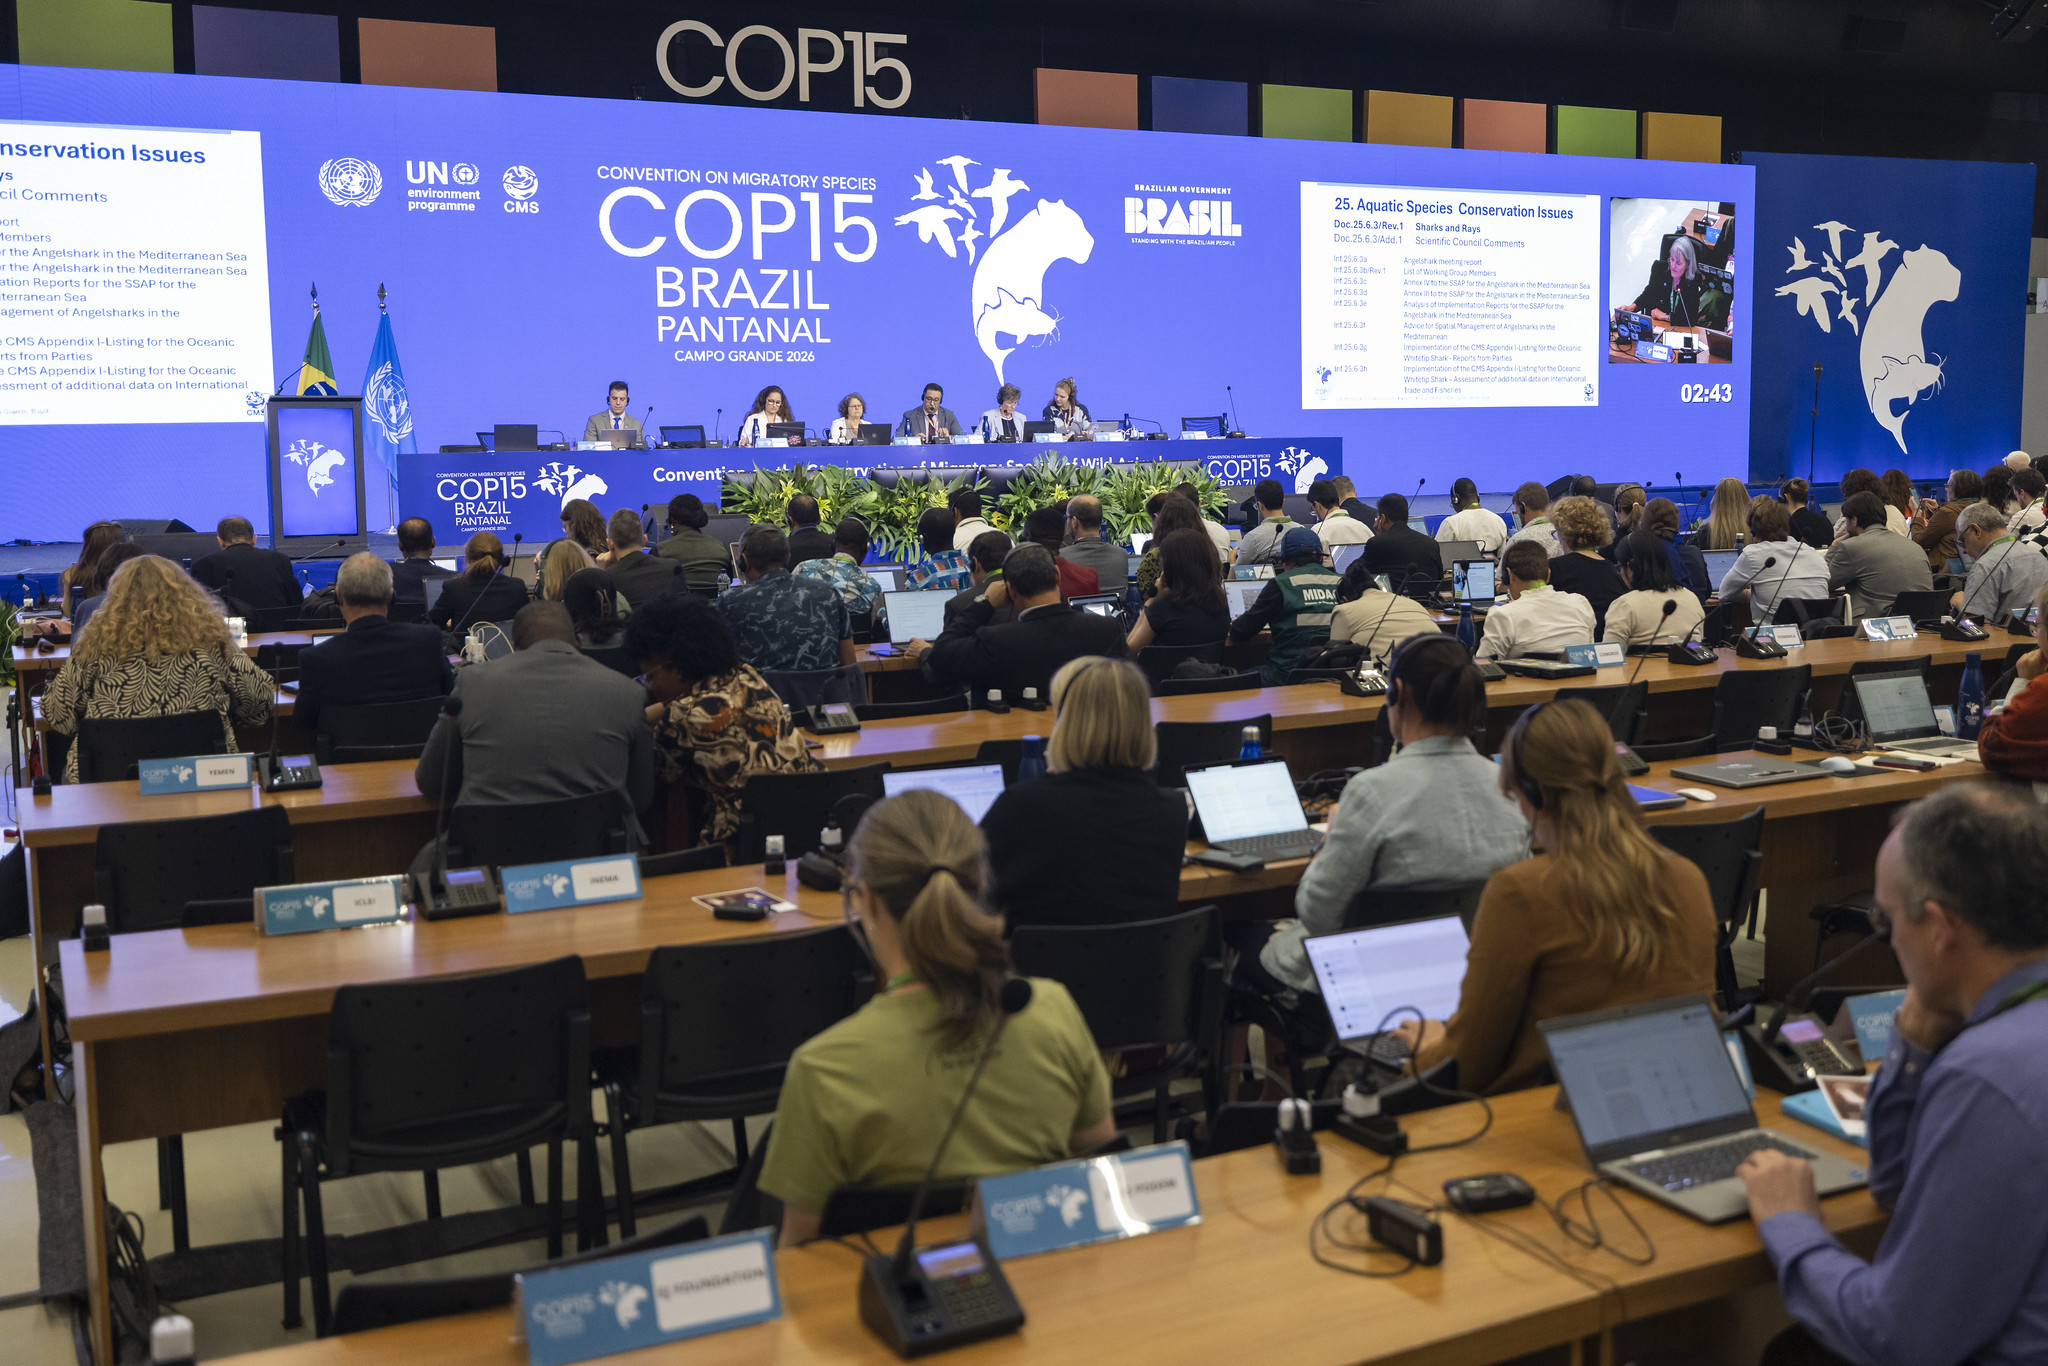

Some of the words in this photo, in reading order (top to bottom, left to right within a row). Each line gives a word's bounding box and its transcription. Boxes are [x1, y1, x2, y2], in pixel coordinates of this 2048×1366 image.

[656, 19, 912, 109] COP15
[0, 142, 125, 160] nservation
[132, 144, 206, 164] Issues
[406, 160, 448, 184] UN
[597, 166, 700, 182] CONVENTION
[706, 170, 728, 184] ON
[733, 172, 818, 188] MIGRATORY
[822, 176, 876, 190] SPECIES
[22, 188, 108, 202] Comments
[408, 188, 481, 200] environment
[1134, 184, 1178, 192] BRAZILIAN
[1180, 186, 1232, 194] GOVERNMENT
[408, 201, 476, 212] programme
[504, 200, 540, 214] CMS
[1335, 197, 1354, 210] 25.
[1357, 198, 1404, 214] Aquatic
[1406, 200, 1453, 216] Species
[1458, 202, 1535, 218] Conservation
[1538, 206, 1574, 219] Issues
[598, 186, 878, 262] COP15
[1124, 197, 1242, 237] BRASIL
[1334, 220, 1404, 230] Doc.25.6.3/Rev.1
[1416, 222, 1443, 232] Sharks
[1445, 224, 1460, 232] and
[1462, 224, 1480, 234] Rays
[1334, 234, 1402, 244] Doc.25.6.3/Add.1
[1416, 236, 1451, 246] Scientific
[1452, 238, 1482, 247] Council
[1484, 238, 1525, 248] Comments
[10, 248, 29, 256] the
[32, 248, 100, 259] Angelshark
[103, 250, 114, 258] in
[116, 250, 135, 258] the
[139, 251, 223, 260] Mediterranean
[226, 253, 247, 261] Sea
[32, 264, 100, 274] Angelshark
[116, 265, 135, 273] the
[139, 265, 223, 274] Mediterranean
[226, 267, 247, 275] Sea
[34, 278, 81, 288] Reports
[84, 279, 100, 287] for
[125, 280, 156, 288] SSAP
[159, 280, 176, 288] for
[178, 281, 196, 289] the
[656, 266, 830, 310] BRAZIL
[64, 293, 87, 301] Sea
[1, 309, 54, 318] agement
[57, 308, 69, 316] of
[72, 308, 145, 318] Angelsharks
[658, 316, 831, 343] PANTANAL
[6, 337, 34, 346] CMS
[38, 337, 94, 347] Appendix
[147, 338, 162, 346] for
[166, 338, 184, 346] the
[188, 338, 234, 346] Oceanic
[20, 352, 48, 360] from
[52, 352, 92, 360] Parties
[674, 350, 726, 362] CAMPO
[728, 350, 783, 362] GRANDE
[786, 350, 815, 362] 2026
[8, 367, 36, 375] CMS
[40, 367, 96, 377] Appendix
[189, 366, 236, 374] Oceanic
[51, 382, 63, 390] of
[176, 381, 248, 389] International
[1680, 384, 1732, 403] 02:43
[1208, 458, 1271, 478] COP15
[436, 476, 527, 501] COP15
[454, 500, 512, 516] BRAZIL
[456, 516, 512, 526] PANTANAL
[209, 768, 235, 776] YEMEN
